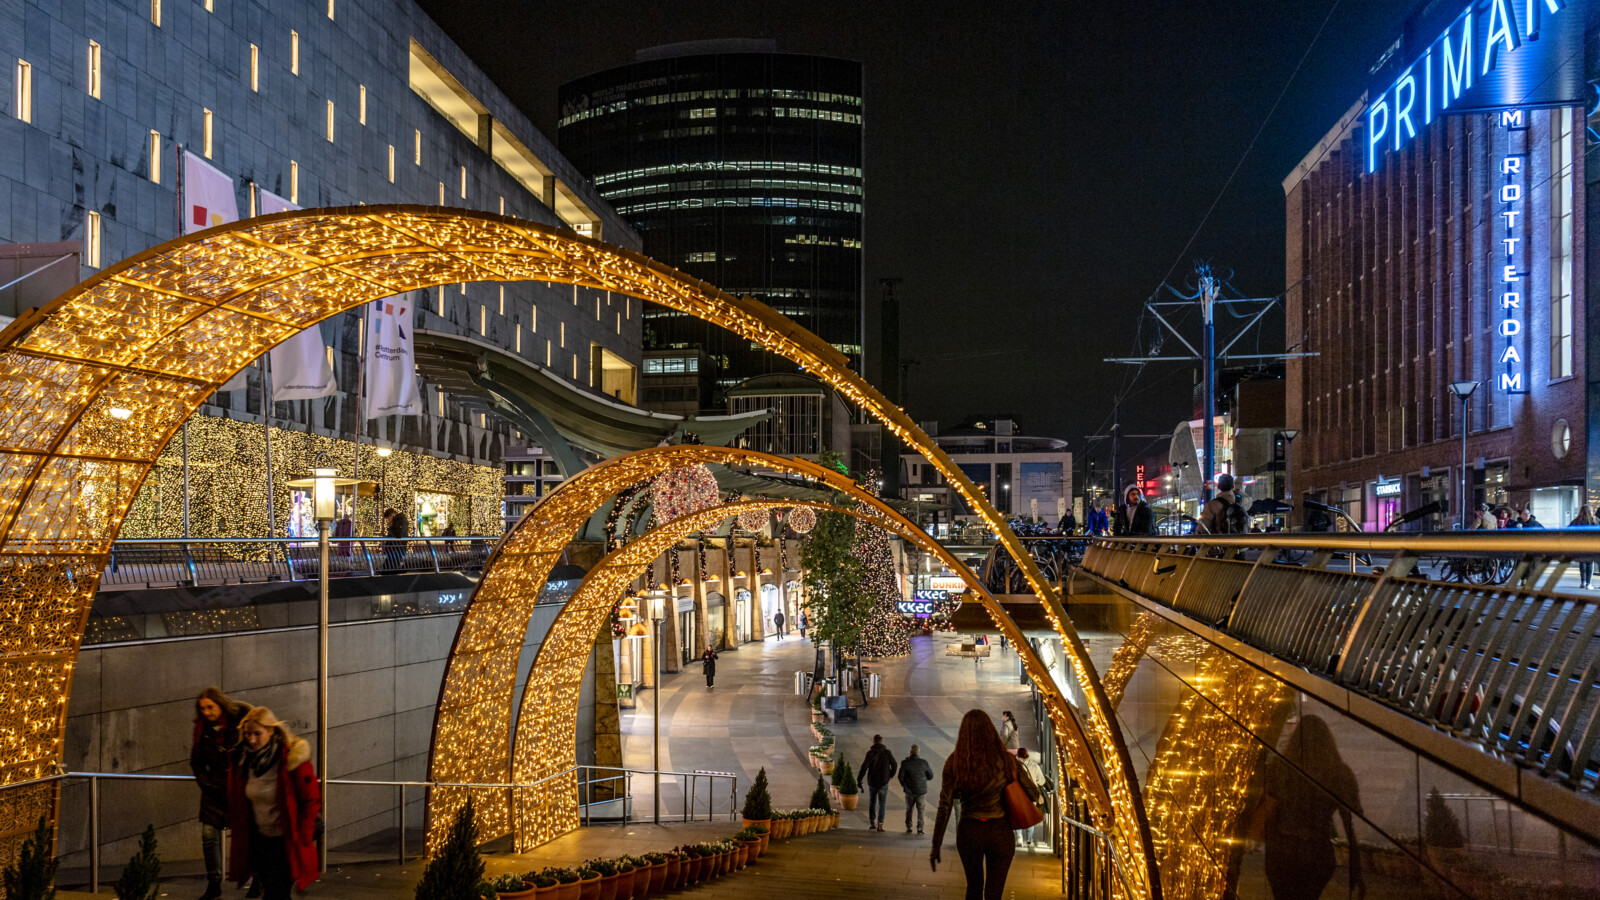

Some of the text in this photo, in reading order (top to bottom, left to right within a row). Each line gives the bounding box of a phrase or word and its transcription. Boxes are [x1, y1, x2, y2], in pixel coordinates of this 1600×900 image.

[616, 82, 639, 92] TRADE
[639, 76, 669, 88] CENTER
[1502, 158, 1521, 391] ROTTERDAM
